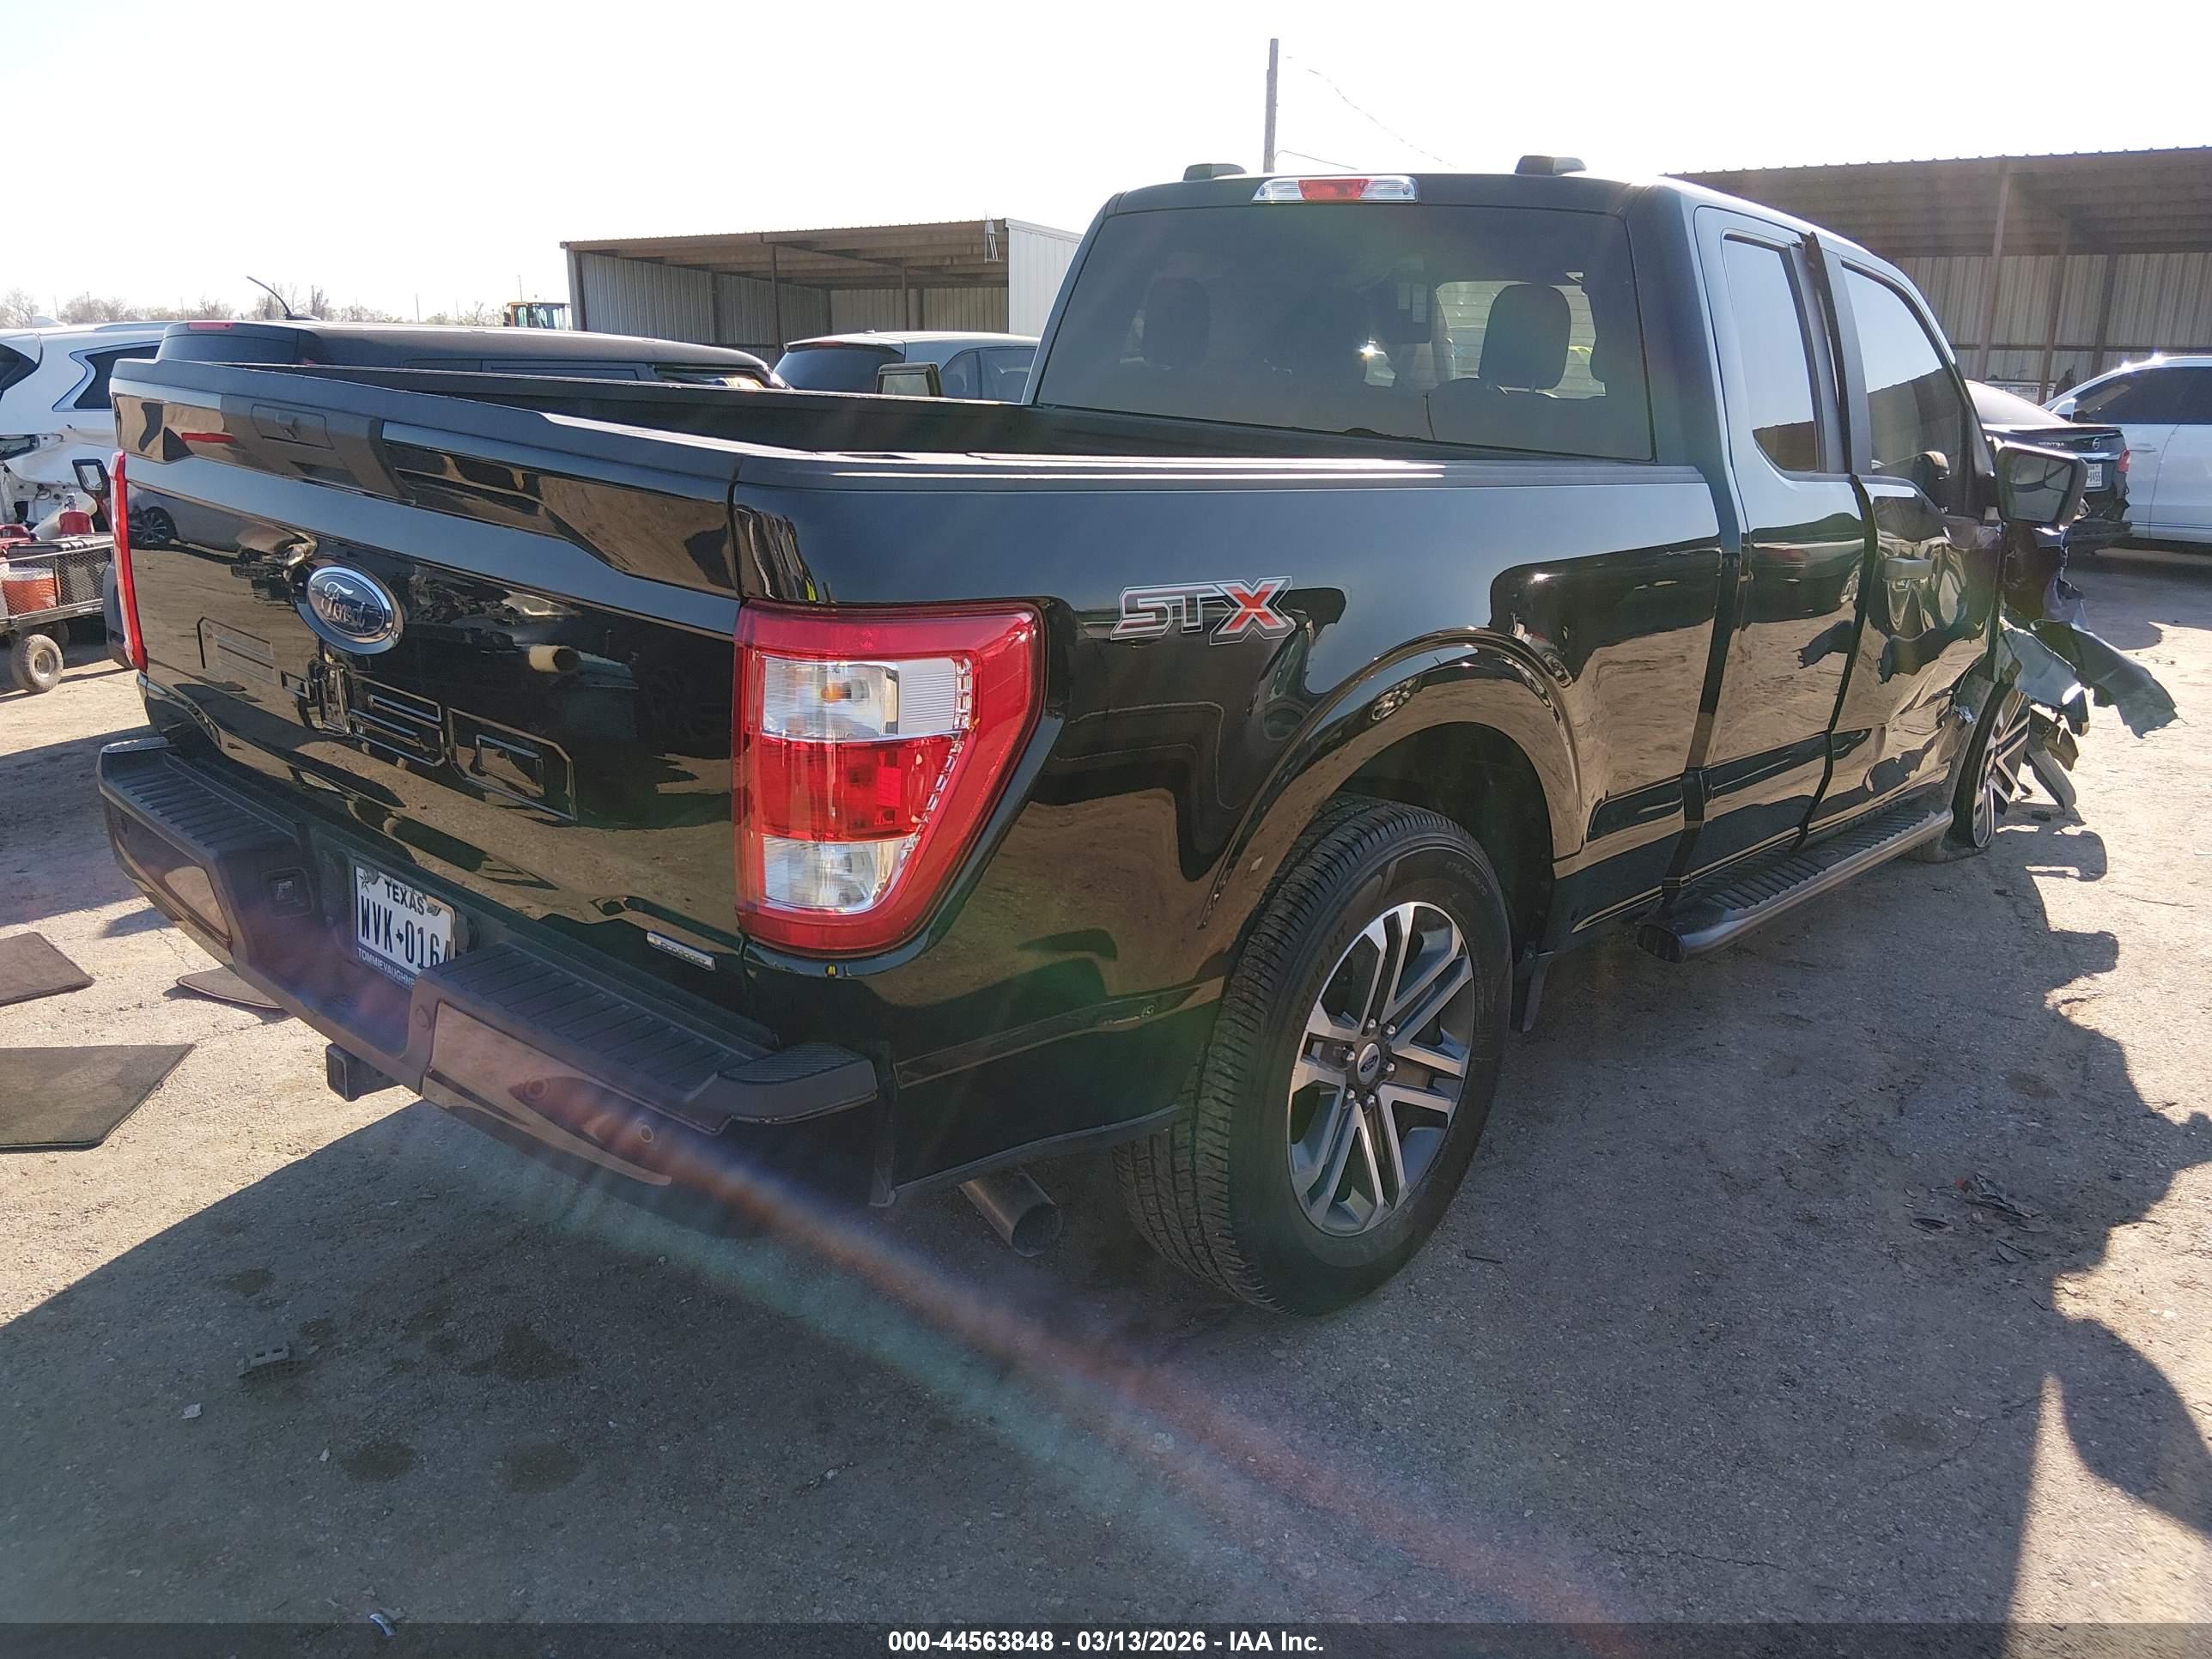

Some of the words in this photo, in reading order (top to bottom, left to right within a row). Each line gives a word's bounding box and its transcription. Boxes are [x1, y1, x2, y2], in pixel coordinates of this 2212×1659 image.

[320, 581, 366, 630] Ford
[1109, 575, 1297, 647] STX
[385, 881, 425, 916] TEXAS
